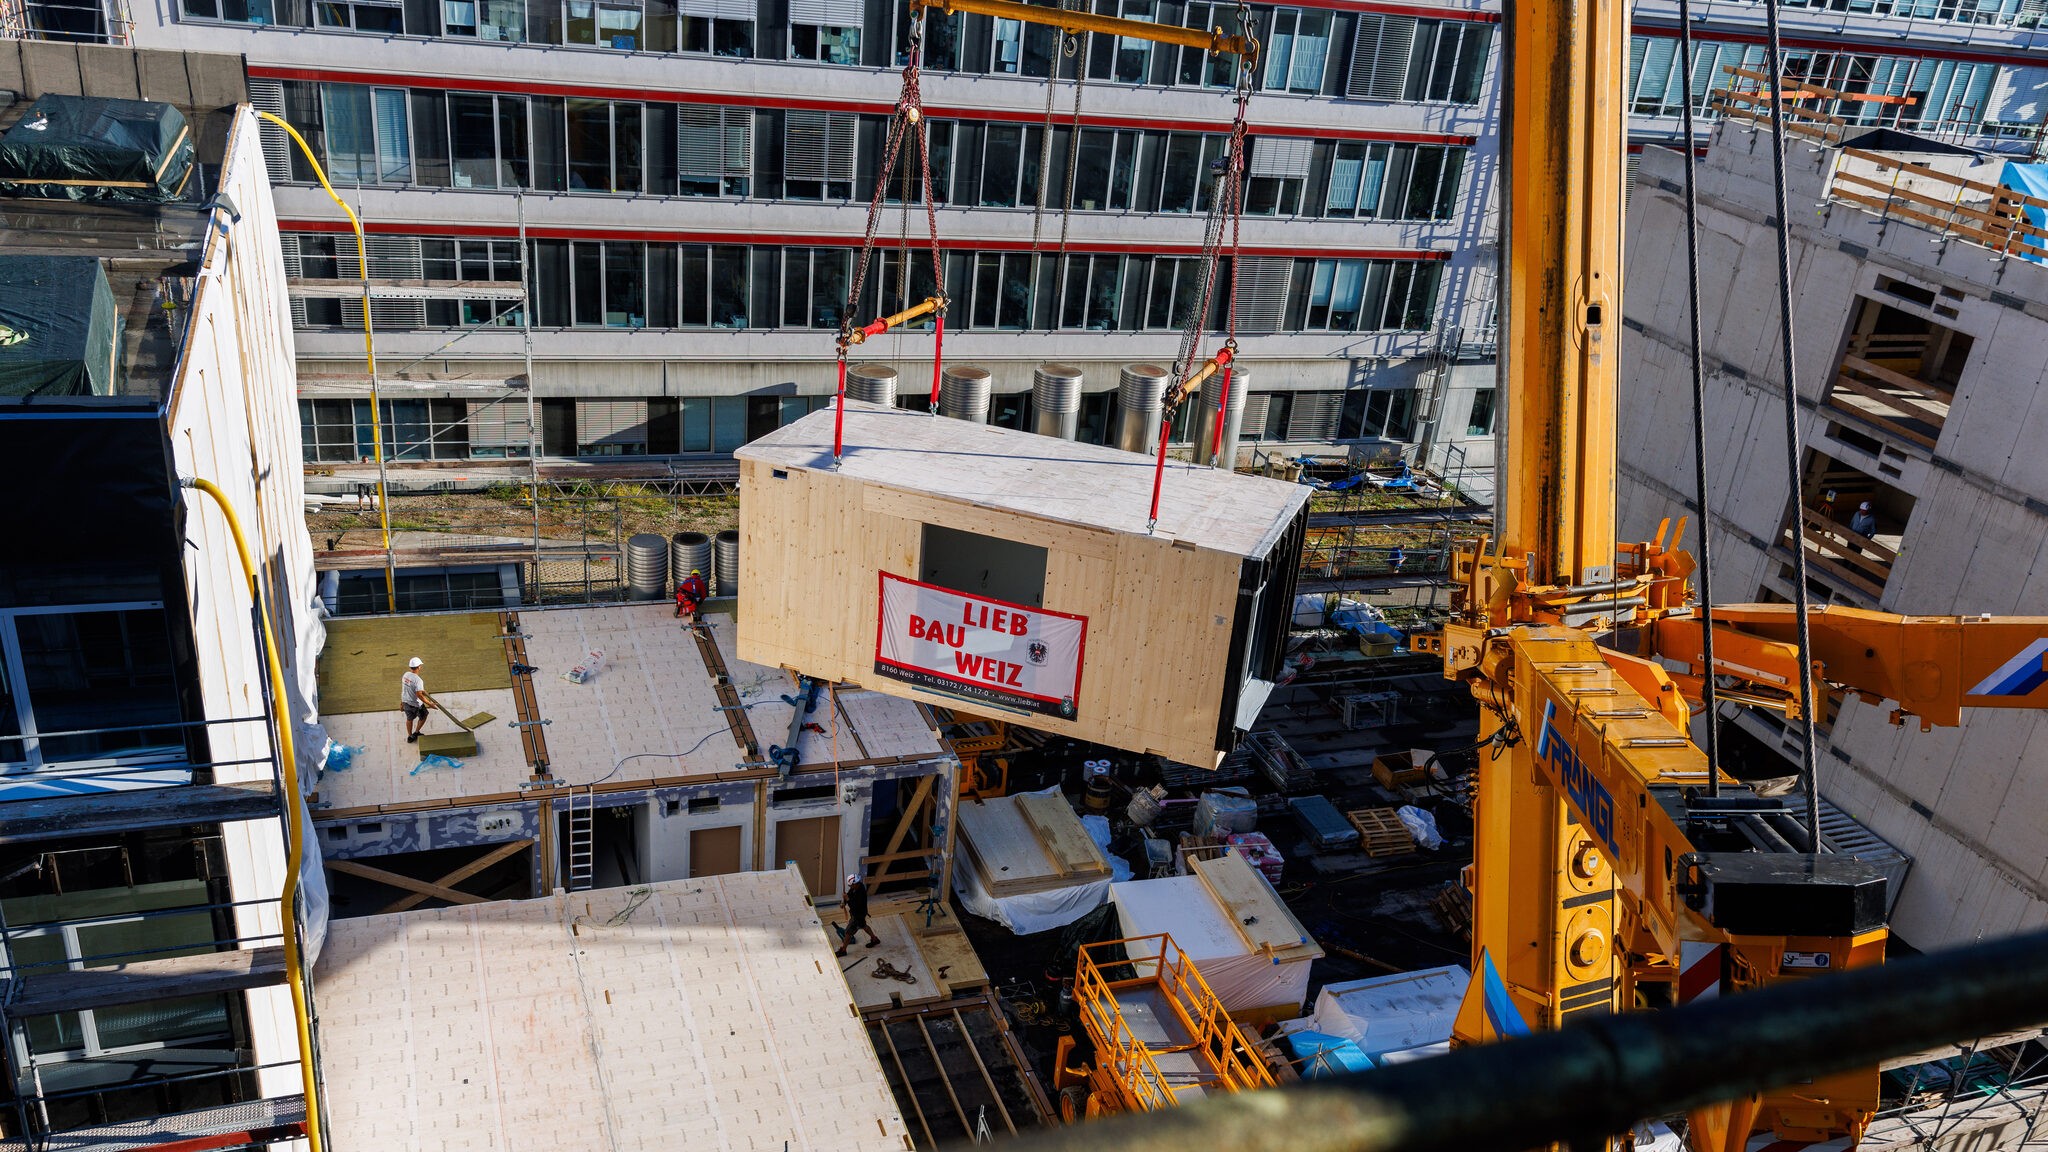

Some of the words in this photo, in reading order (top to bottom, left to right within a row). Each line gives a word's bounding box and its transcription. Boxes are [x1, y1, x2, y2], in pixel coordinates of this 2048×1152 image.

[908, 614, 965, 648] BAU
[963, 601, 1028, 636] LIEB
[881, 664, 898, 674] 8160
[899, 669, 915, 679] Weiz
[923, 675, 936, 684] Tel.
[936, 678, 958, 689] 03172
[998, 694, 1040, 708] www.lieb.at
[954, 650, 1023, 687] WEIZ
